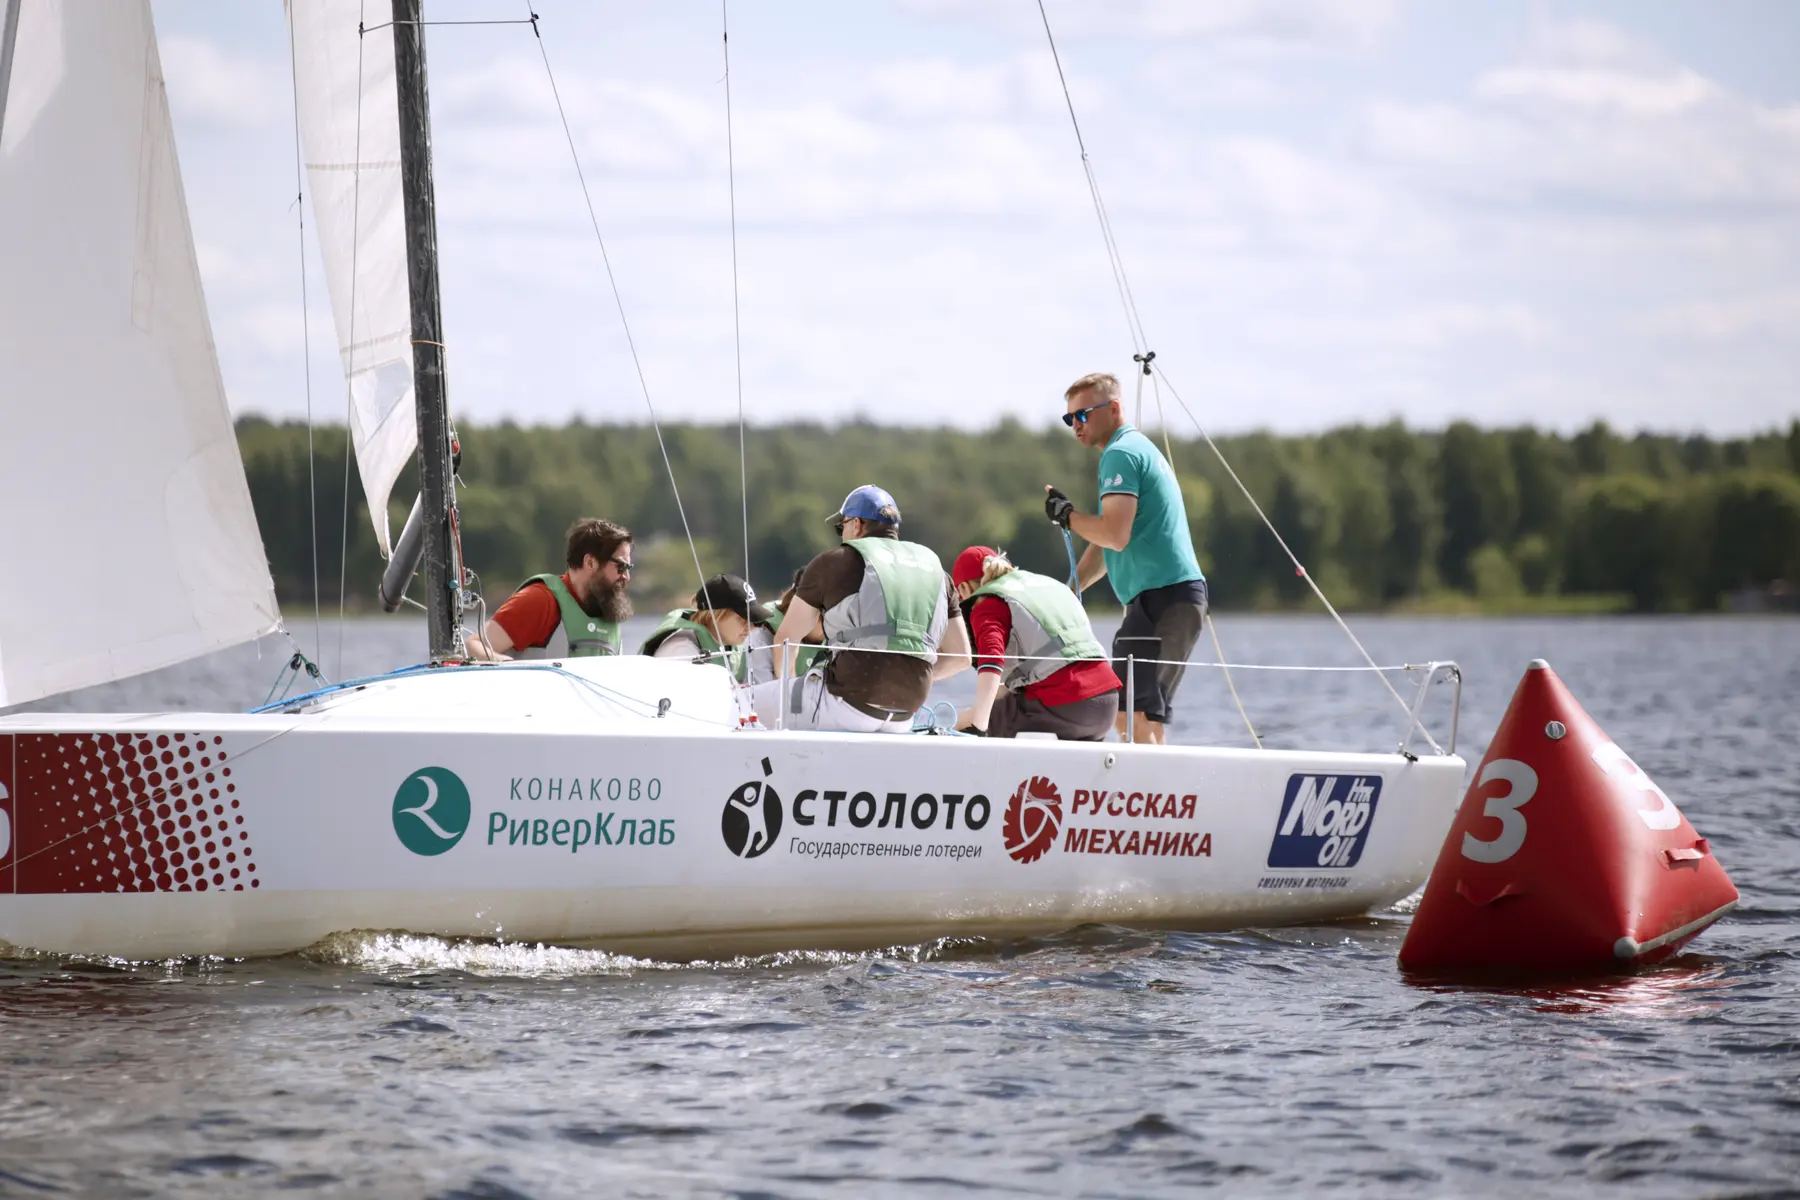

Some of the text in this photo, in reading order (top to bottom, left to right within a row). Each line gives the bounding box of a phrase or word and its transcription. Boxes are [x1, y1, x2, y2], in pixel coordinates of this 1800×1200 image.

[510, 777, 662, 801] КОНАКОВО
[1071, 789, 1198, 820] РУССКАЯ
[792, 789, 991, 831] СТОЛОТО
[1460, 758, 1539, 864] 3
[487, 812, 676, 853] РиверКлаб
[1063, 828, 1212, 857] МЕХАНИКА
[790, 837, 982, 862] Государственные лотереи
